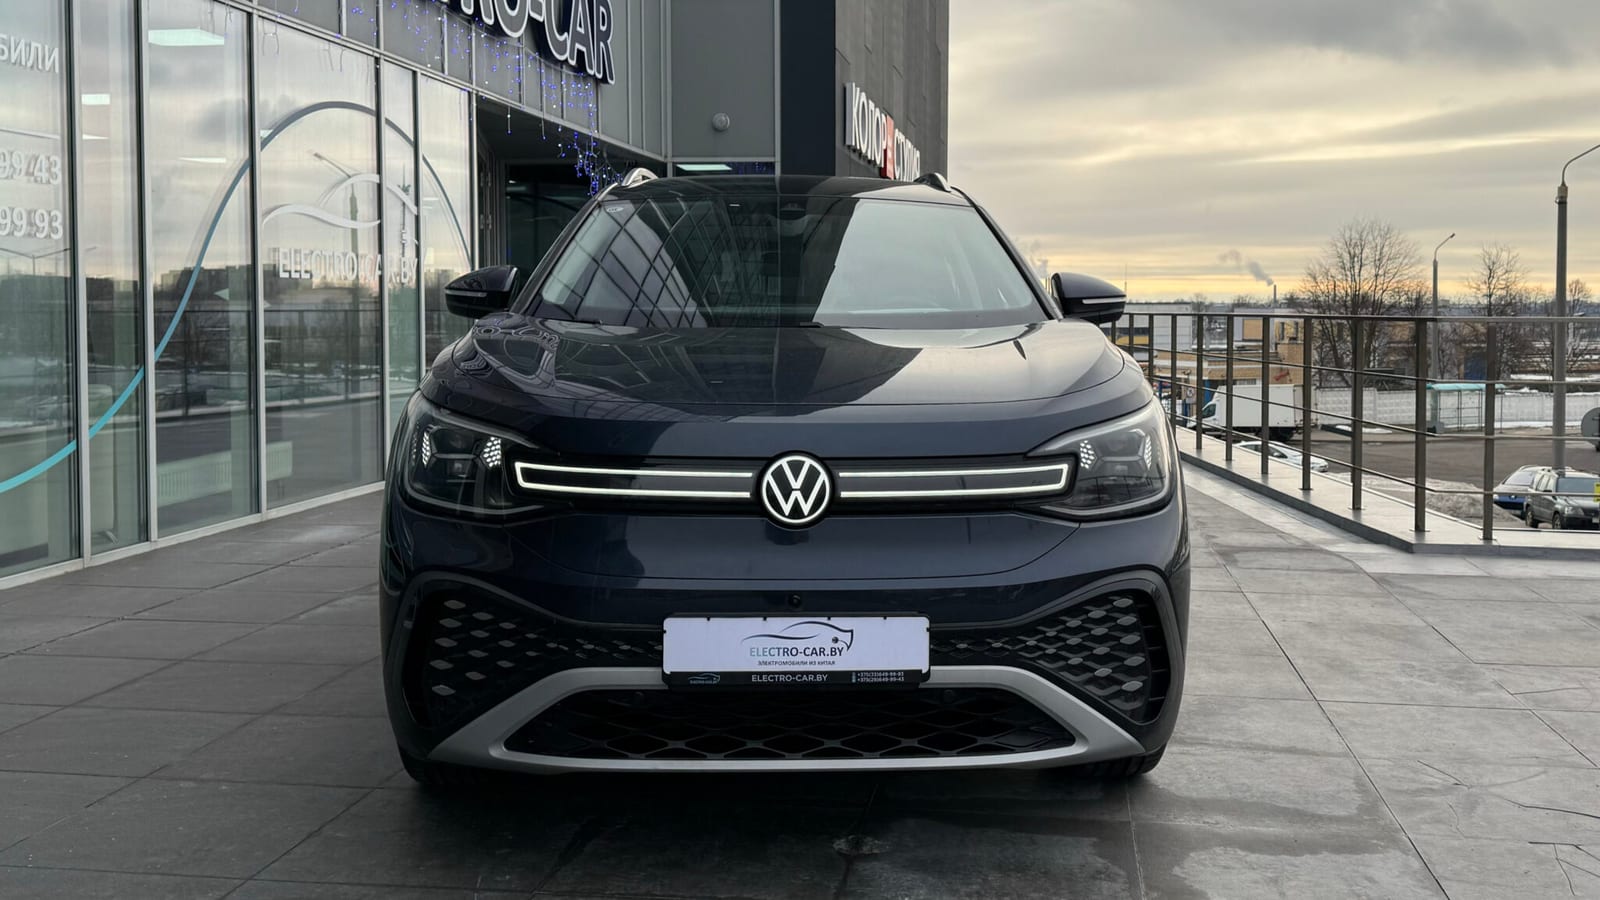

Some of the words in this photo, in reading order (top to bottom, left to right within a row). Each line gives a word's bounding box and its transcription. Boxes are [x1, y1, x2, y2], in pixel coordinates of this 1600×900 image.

[35, 208, 63, 239] 93
[749, 646, 844, 657] ELECTRO-CAR.BY
[751, 674, 828, 682] ELECTRO-CAR.BY
